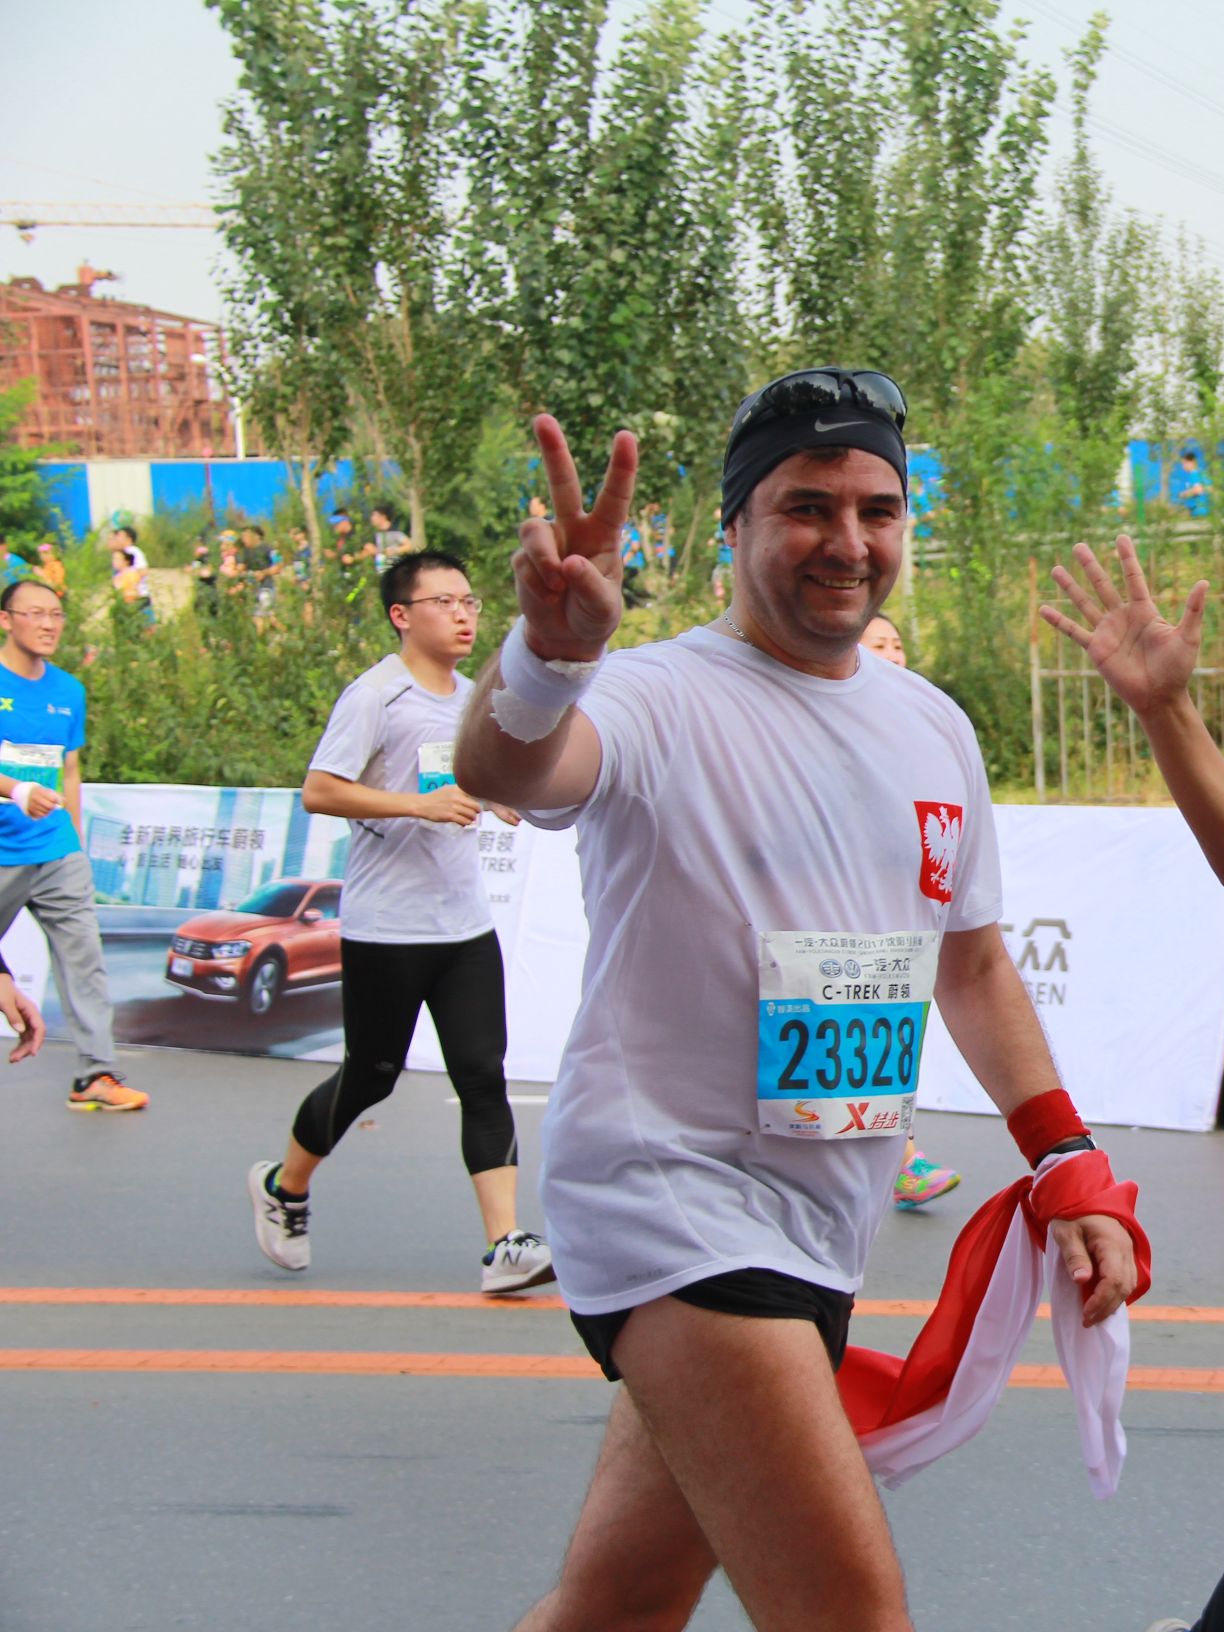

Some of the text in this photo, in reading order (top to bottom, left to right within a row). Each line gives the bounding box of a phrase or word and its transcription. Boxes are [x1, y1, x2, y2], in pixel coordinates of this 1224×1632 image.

[822, 983, 911, 1000] C-TREK 蔚领
[777, 1016, 915, 1091] 23328
